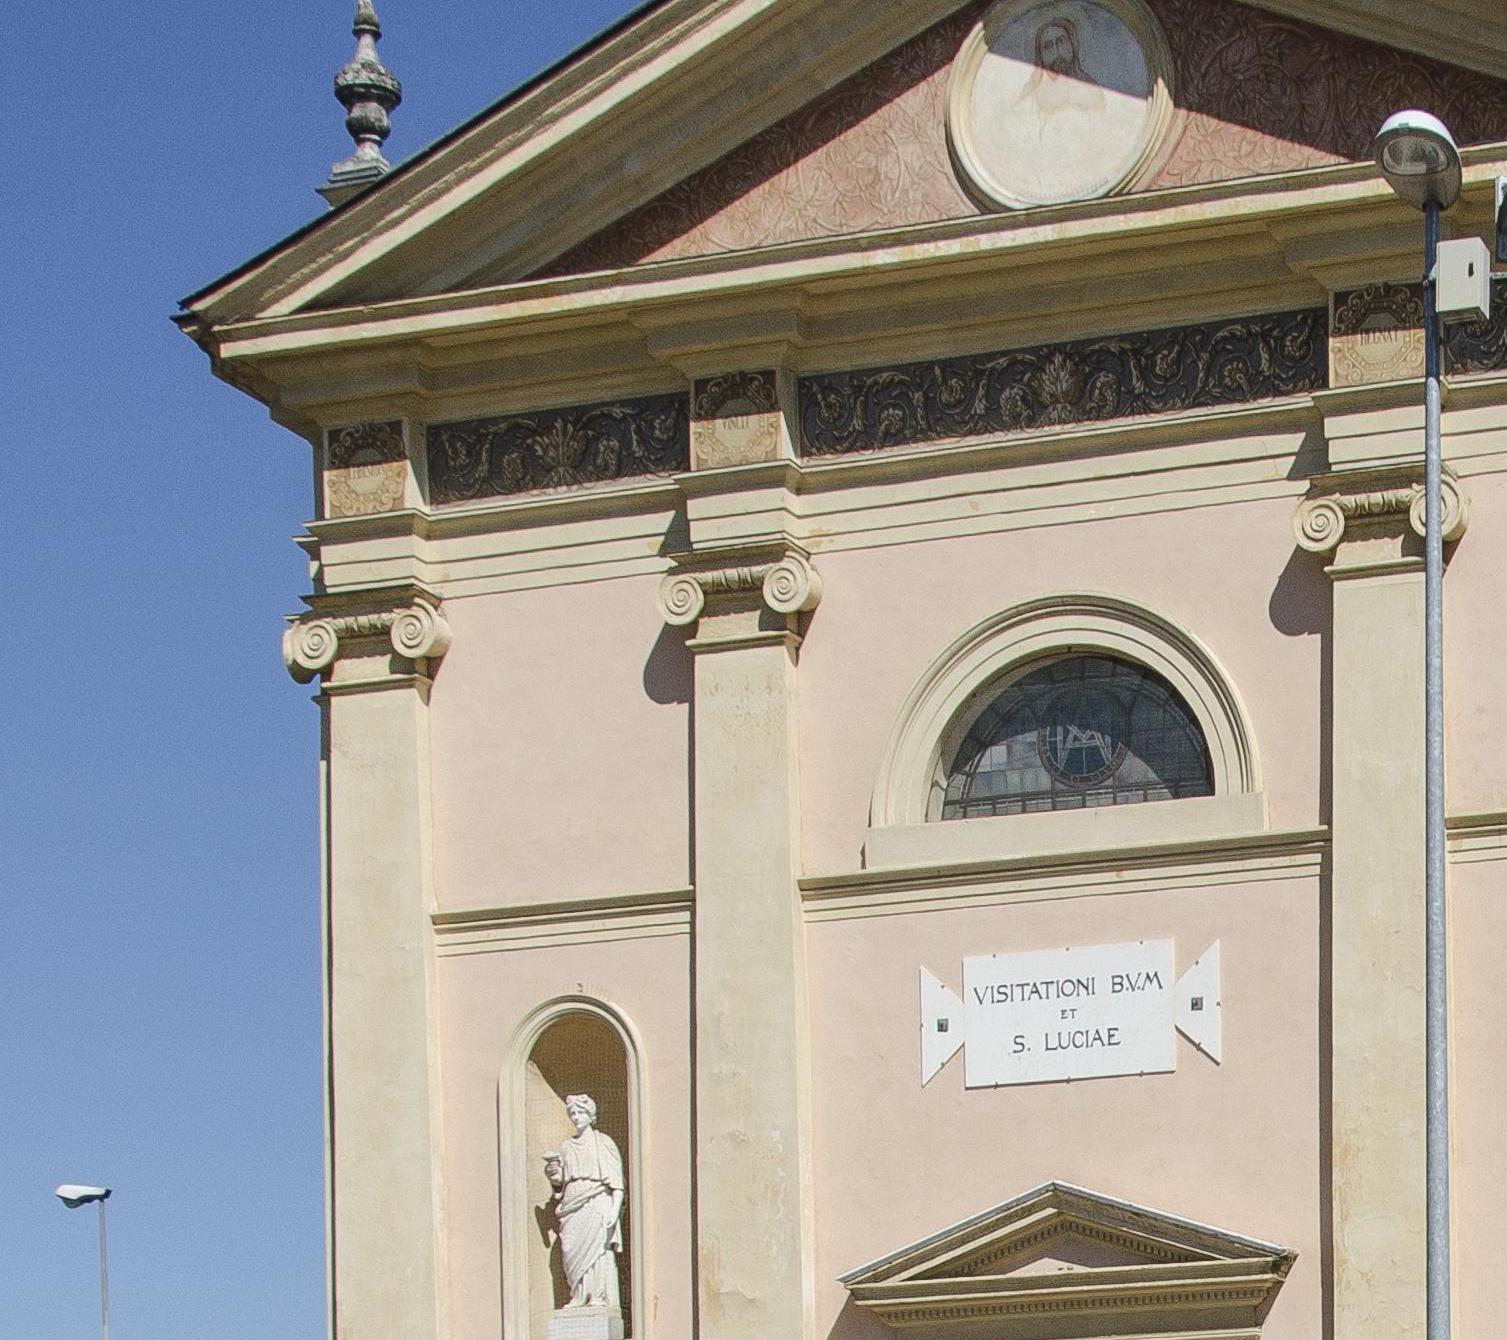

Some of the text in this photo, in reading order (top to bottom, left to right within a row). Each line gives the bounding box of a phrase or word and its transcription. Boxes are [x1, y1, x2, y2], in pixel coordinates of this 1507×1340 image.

[973, 976, 1096, 1006] VISITATIONI
[1060, 1008, 1077, 1020] ET
[1012, 1027, 1122, 1054] S. LUCIAE
